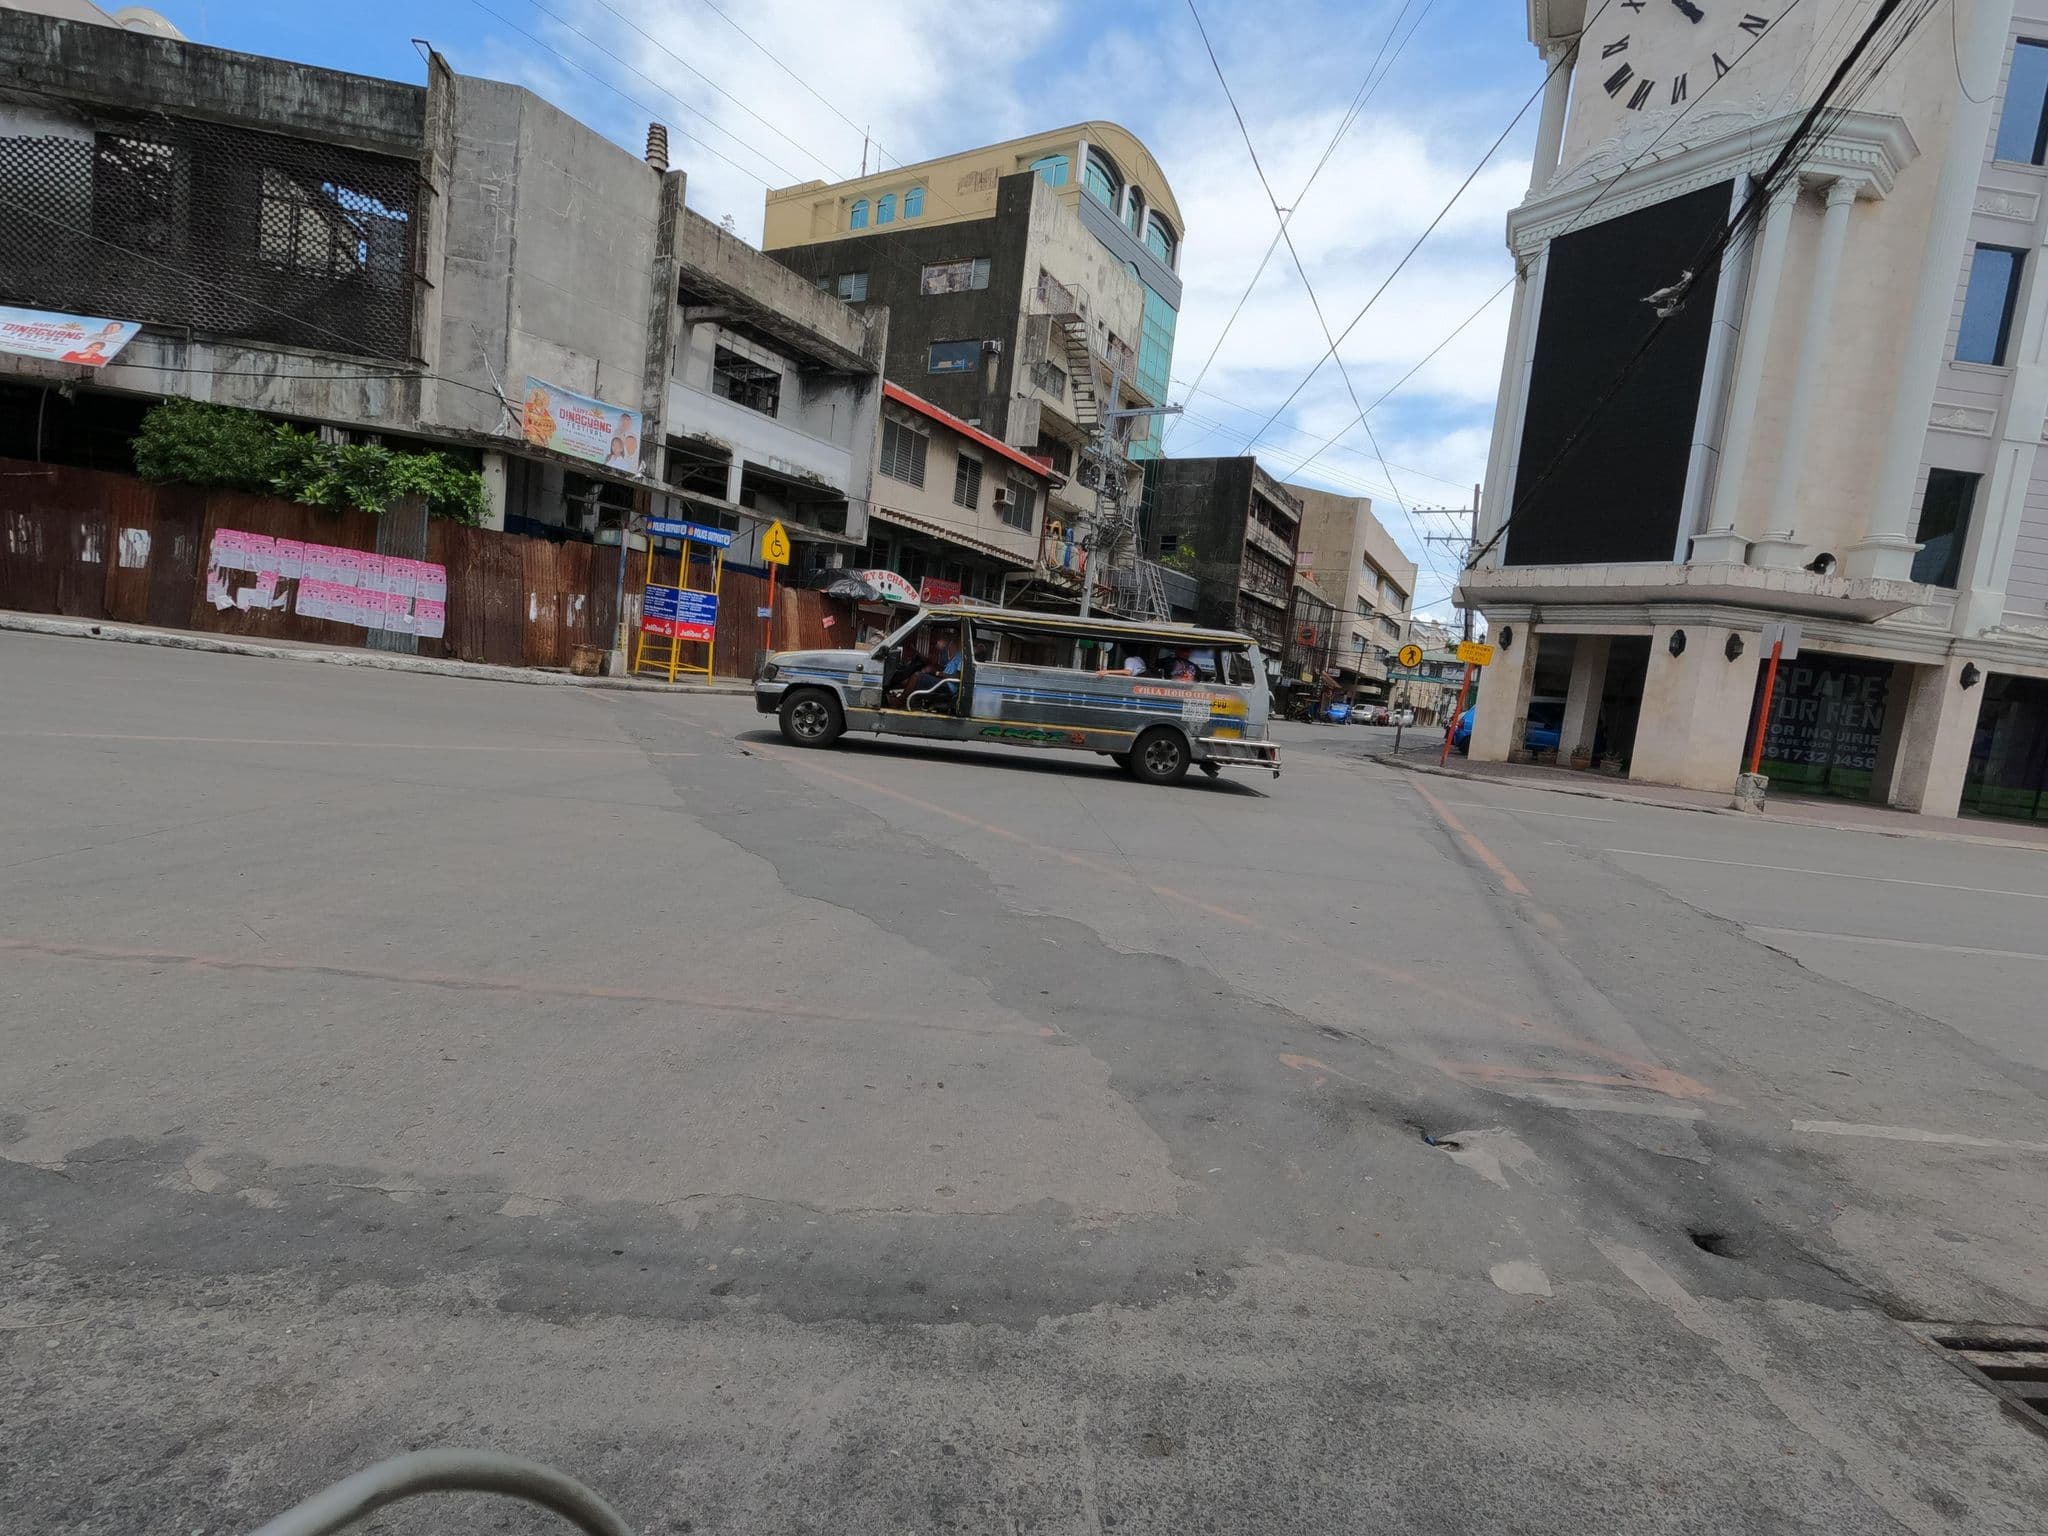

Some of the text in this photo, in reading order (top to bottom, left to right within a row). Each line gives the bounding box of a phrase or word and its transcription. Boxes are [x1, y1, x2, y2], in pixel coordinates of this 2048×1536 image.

[1827, 700, 1883, 729] REN
[1767, 723, 1880, 746] OR INQUIRIE
